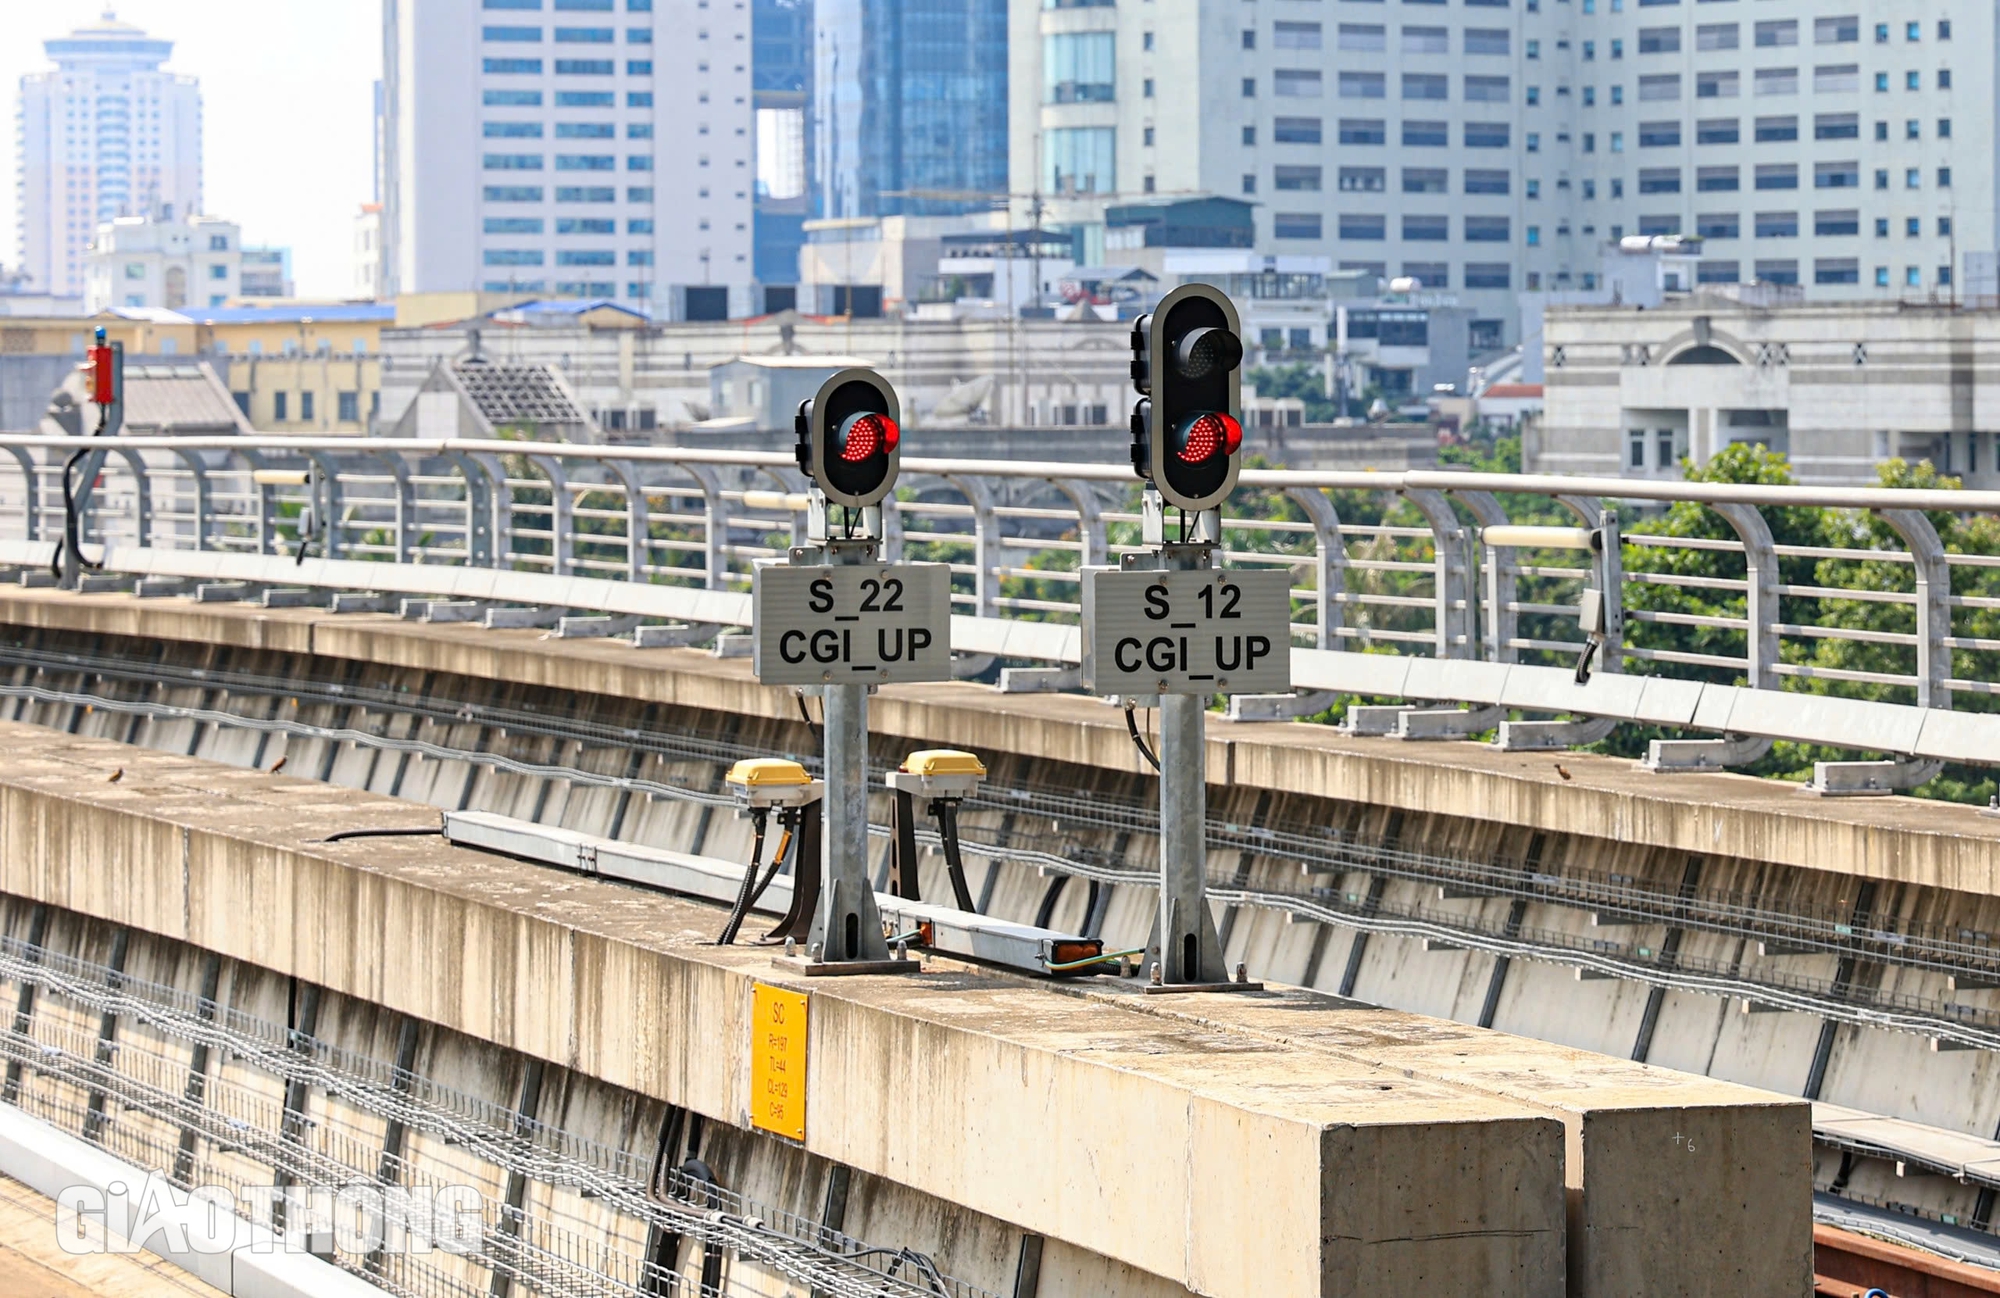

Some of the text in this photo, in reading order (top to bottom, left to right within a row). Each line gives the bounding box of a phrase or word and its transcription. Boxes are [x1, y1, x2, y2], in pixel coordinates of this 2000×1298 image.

[809, 579, 903, 621] S_22
[1144, 584, 1241, 629] S_12
[779, 628, 932, 671] CGI_UP
[1114, 635, 1271, 680] CGI_UP
[773, 1002, 785, 1025] SC
[768, 1033, 788, 1052] R=197
[769, 1055, 786, 1074] TL=44
[767, 1078, 788, 1098] CL=129
